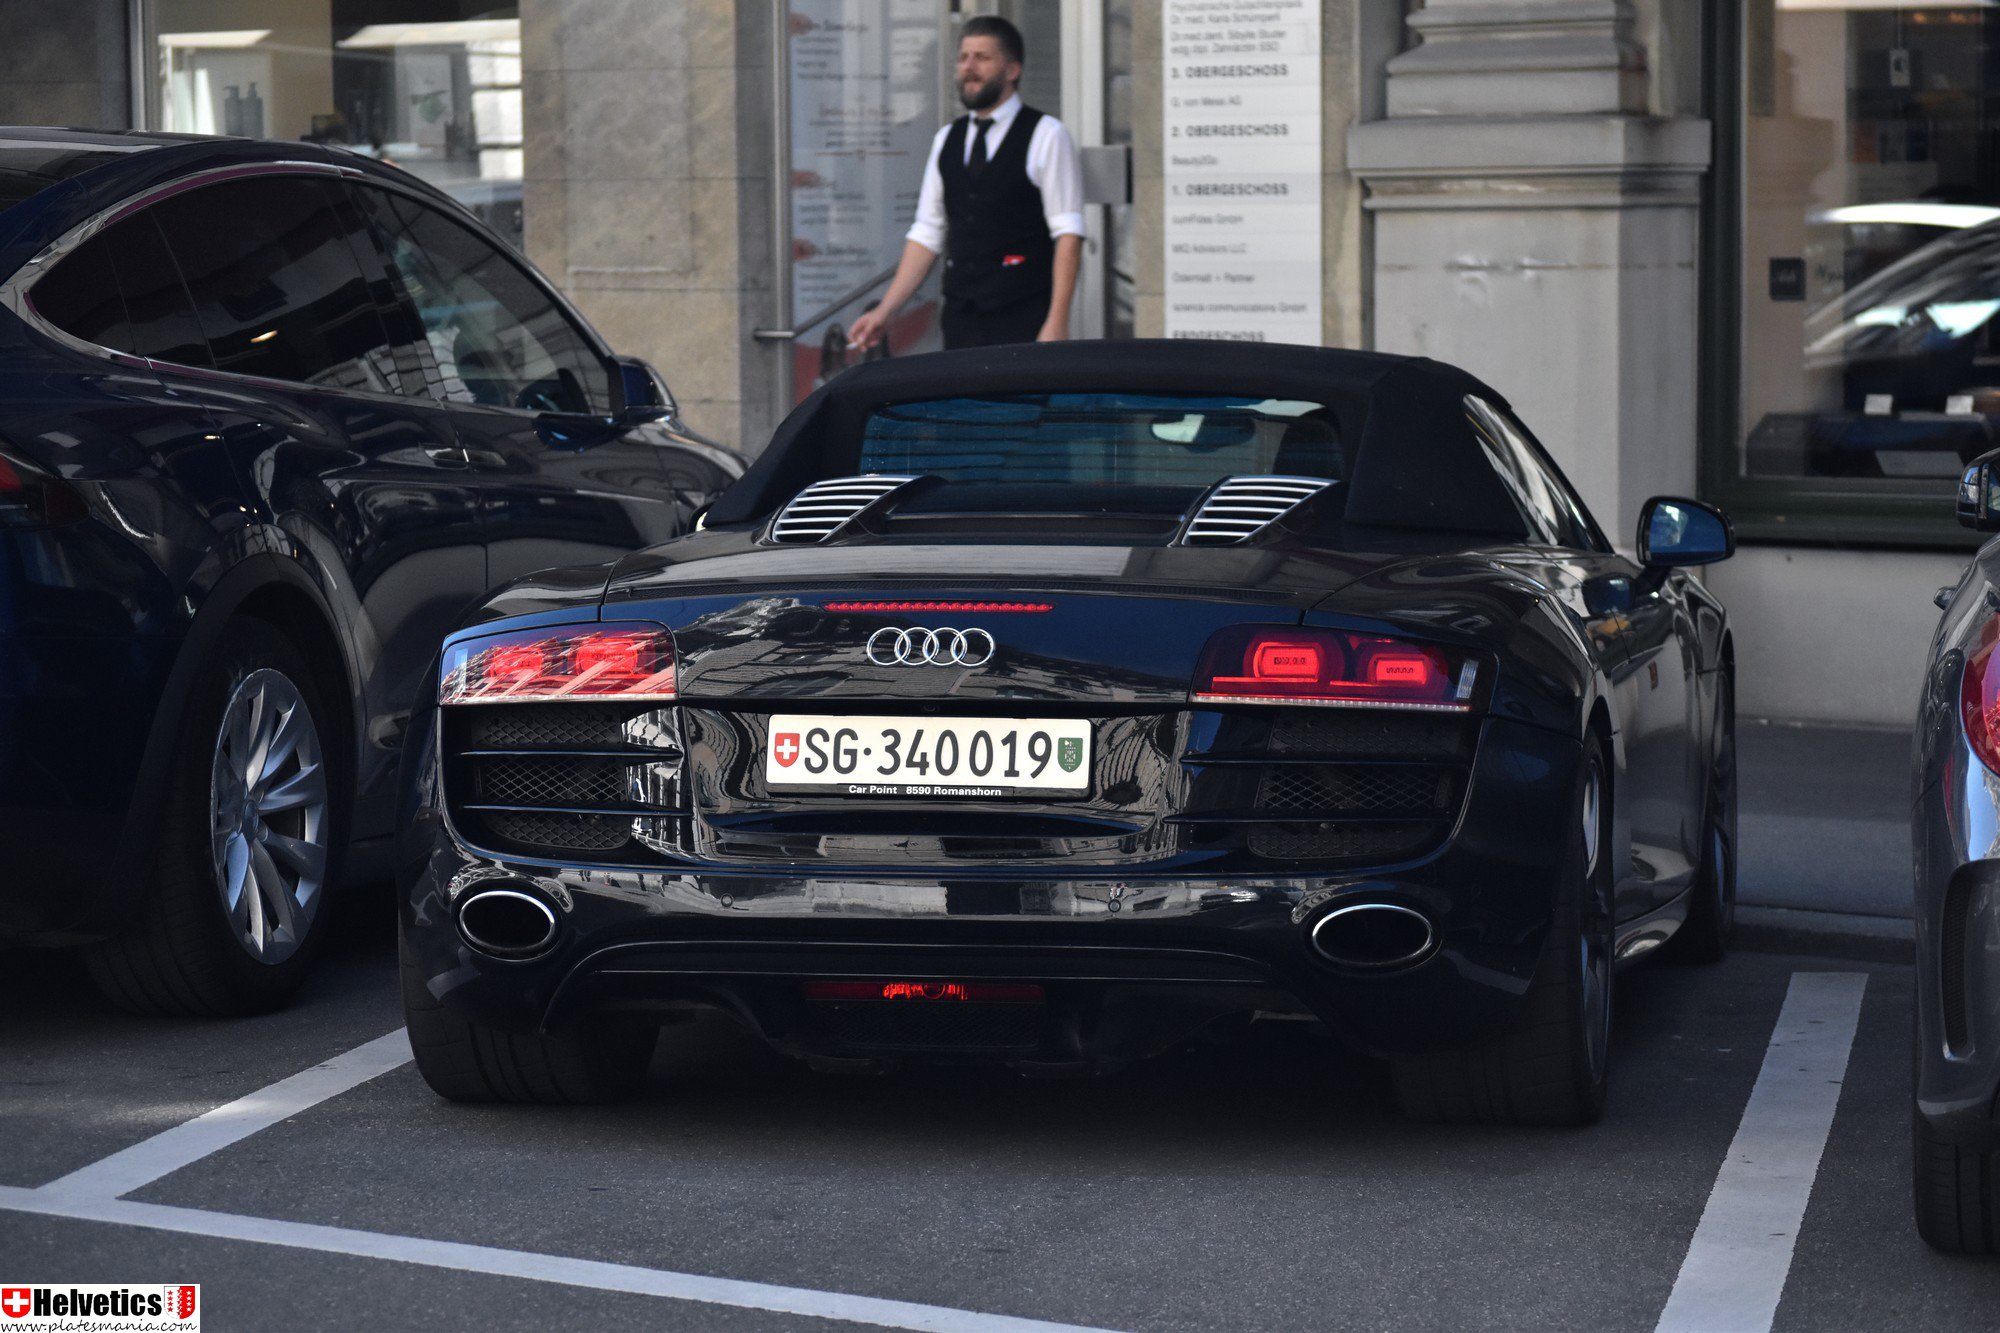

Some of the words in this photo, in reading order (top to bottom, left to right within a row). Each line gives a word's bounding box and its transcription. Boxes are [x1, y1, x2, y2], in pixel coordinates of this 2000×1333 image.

[1185, 64, 1288, 78] OBERGESCHOSS
[1185, 124, 1288, 137] OBERGESCHOSS
[1185, 183, 1288, 196] OBERGESCHOSS
[848, 785, 866, 794] Car
[870, 785, 898, 794] Point
[906, 786, 931, 795] 8590
[934, 786, 1001, 796] Romanshorn
